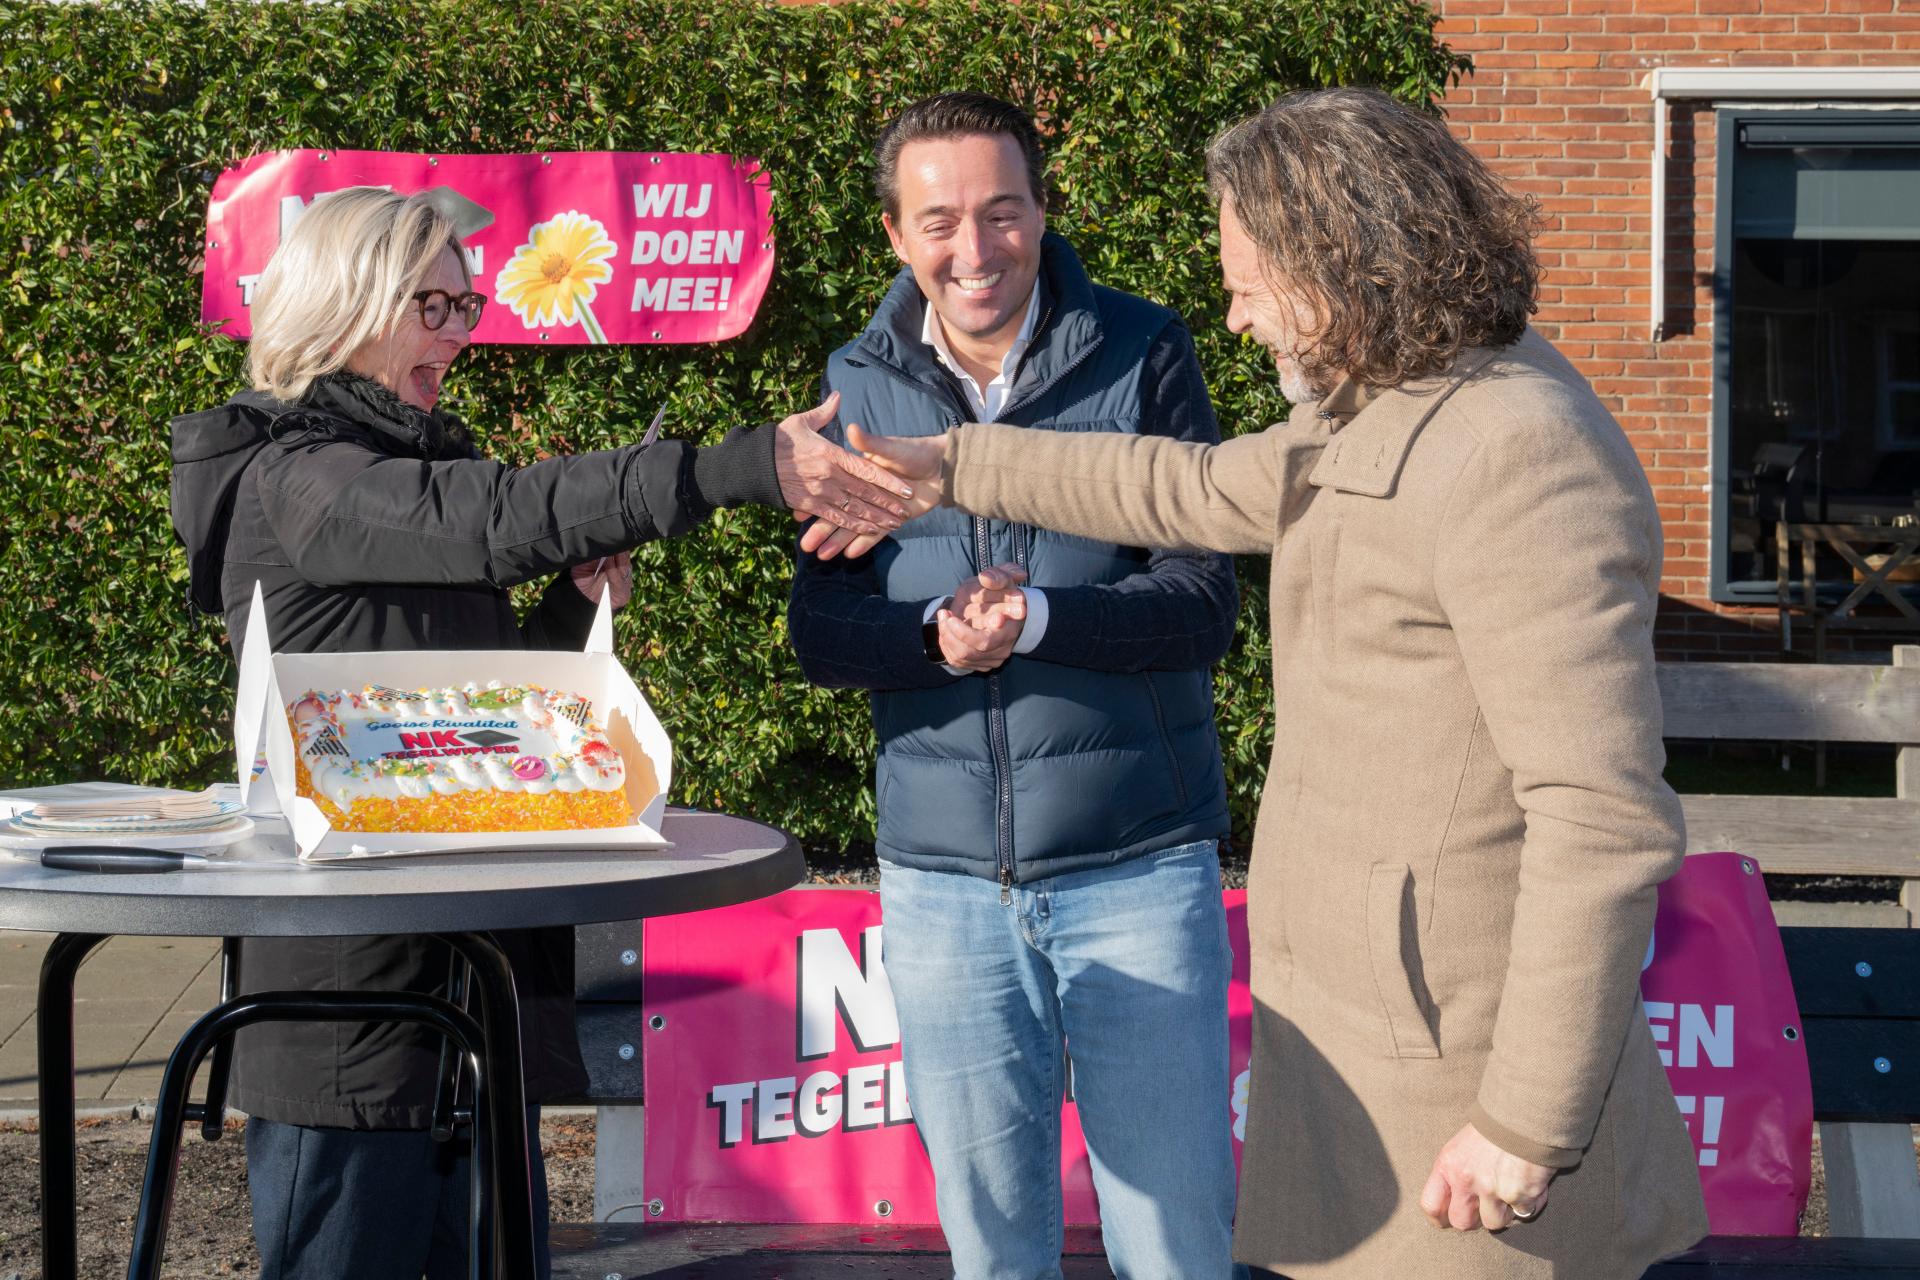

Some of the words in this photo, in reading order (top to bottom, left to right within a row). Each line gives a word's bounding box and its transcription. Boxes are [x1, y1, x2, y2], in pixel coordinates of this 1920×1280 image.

[632, 183, 713, 218] WIJ
[630, 229, 745, 265] DOEN
[630, 277, 733, 312] MEE!
[381, 745, 519, 760] TEGELWIPPEN
[399, 729, 465, 749] NK
[796, 925, 901, 1063] N
[1641, 1000, 1735, 1068] EN
[706, 1060, 914, 1149] TEGEL
